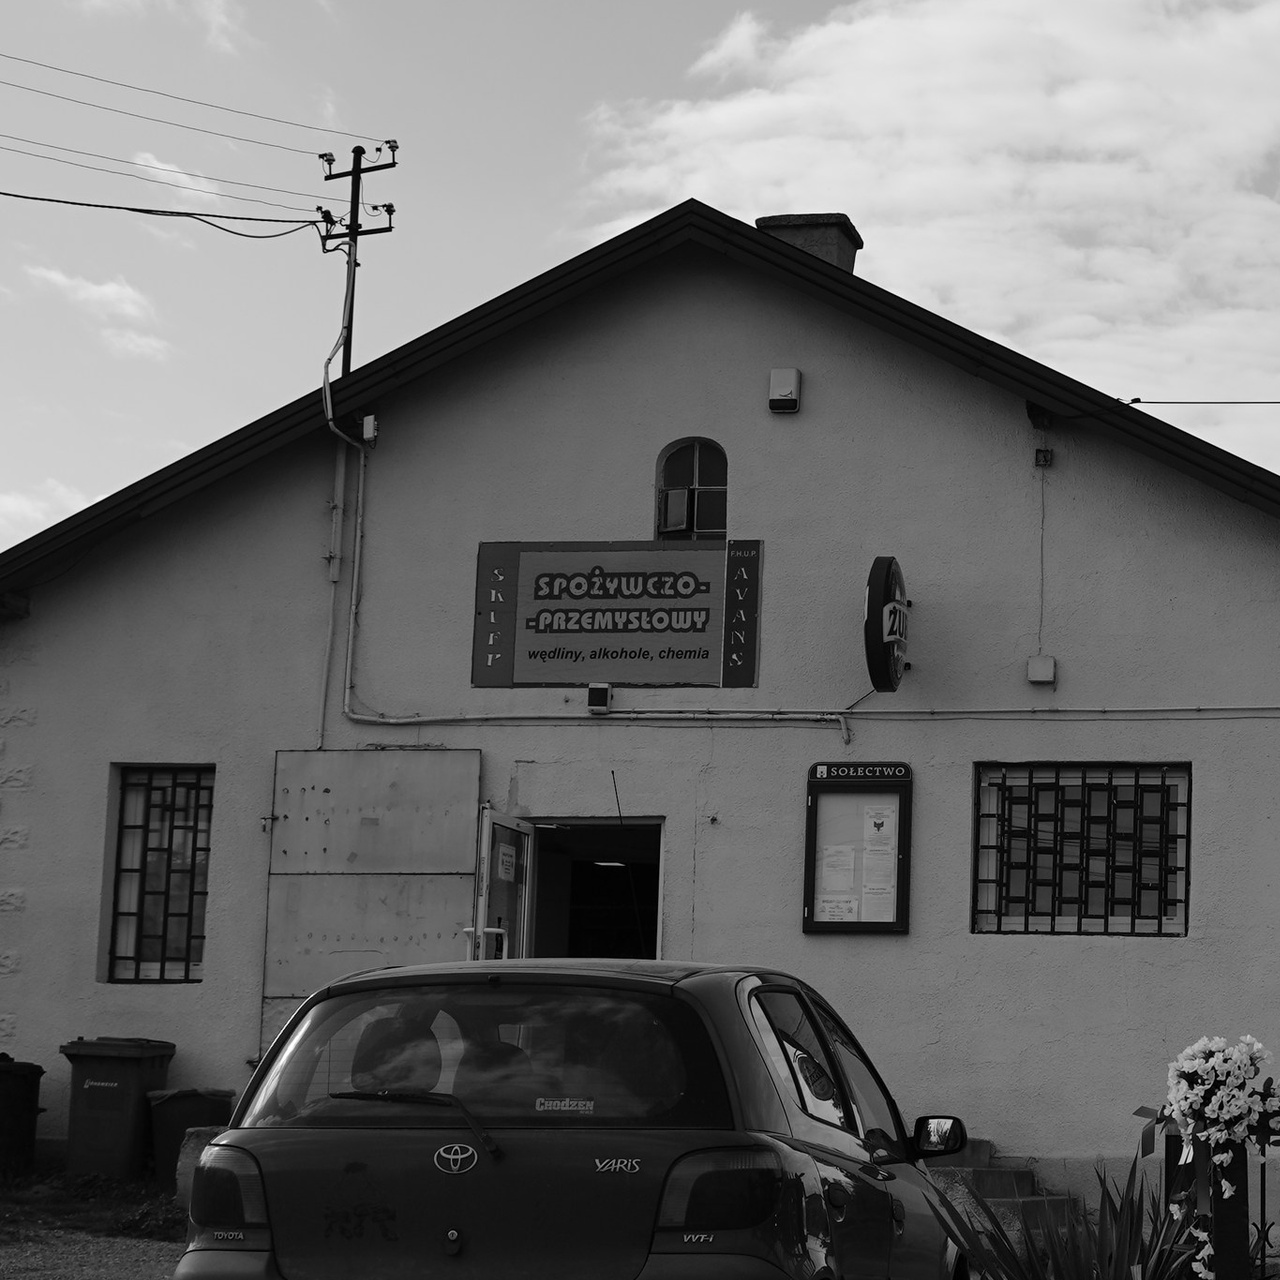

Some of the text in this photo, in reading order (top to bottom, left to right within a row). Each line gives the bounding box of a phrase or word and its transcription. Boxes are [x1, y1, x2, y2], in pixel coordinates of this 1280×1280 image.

[527, 646, 710, 663] wędliny, alkohole, chemia
[830, 766, 906, 776] SOŁECTWO
[213, 1231, 244, 1240] TOYOTA
